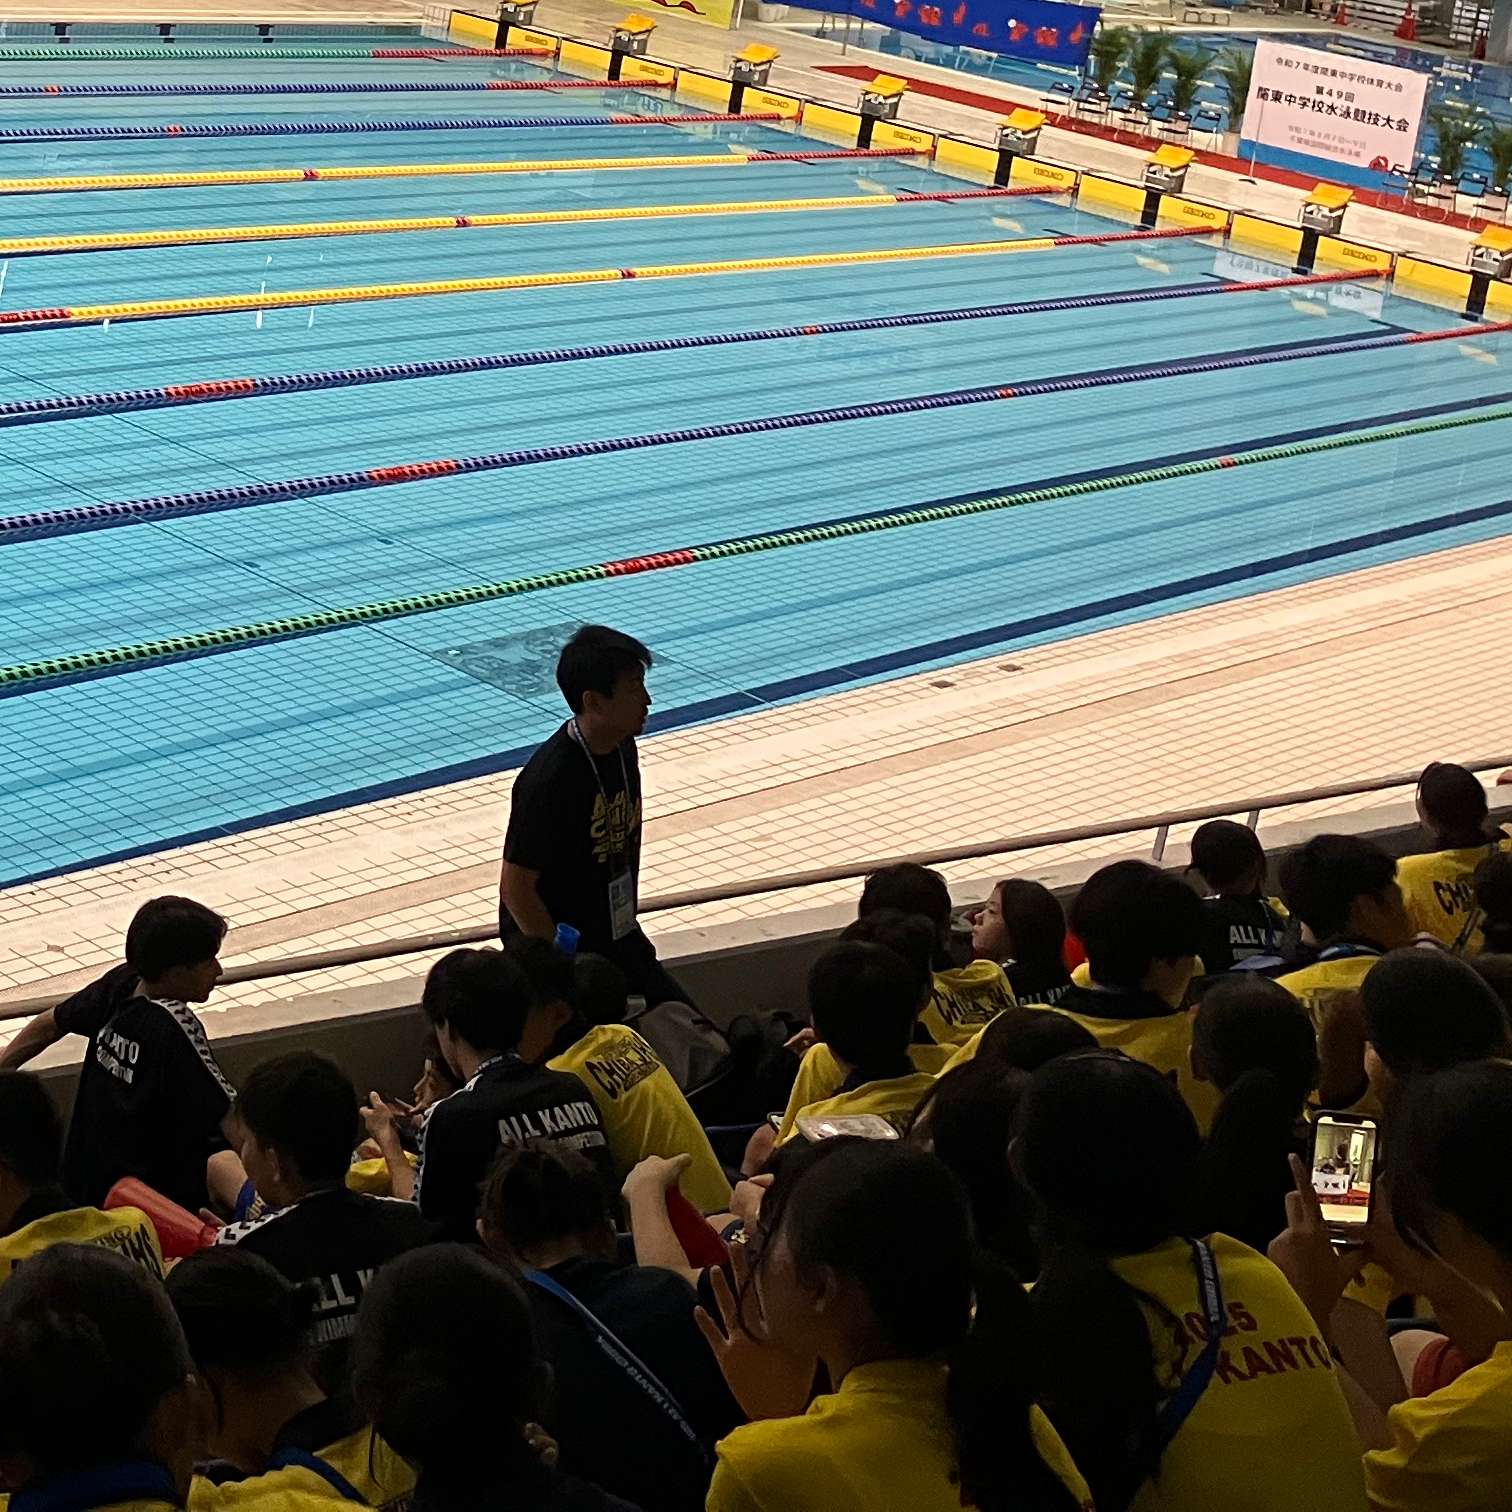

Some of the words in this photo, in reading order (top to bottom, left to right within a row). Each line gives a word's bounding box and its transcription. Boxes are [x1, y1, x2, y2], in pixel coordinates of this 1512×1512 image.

[1255, 85, 1411, 133] 関東中学校水泳競技大会
[1229, 924, 1260, 944] ALL
[497, 1113, 541, 1145] ALL
[538, 1100, 599, 1134] KANTO
[1215, 1335, 1333, 1385] KANTO
